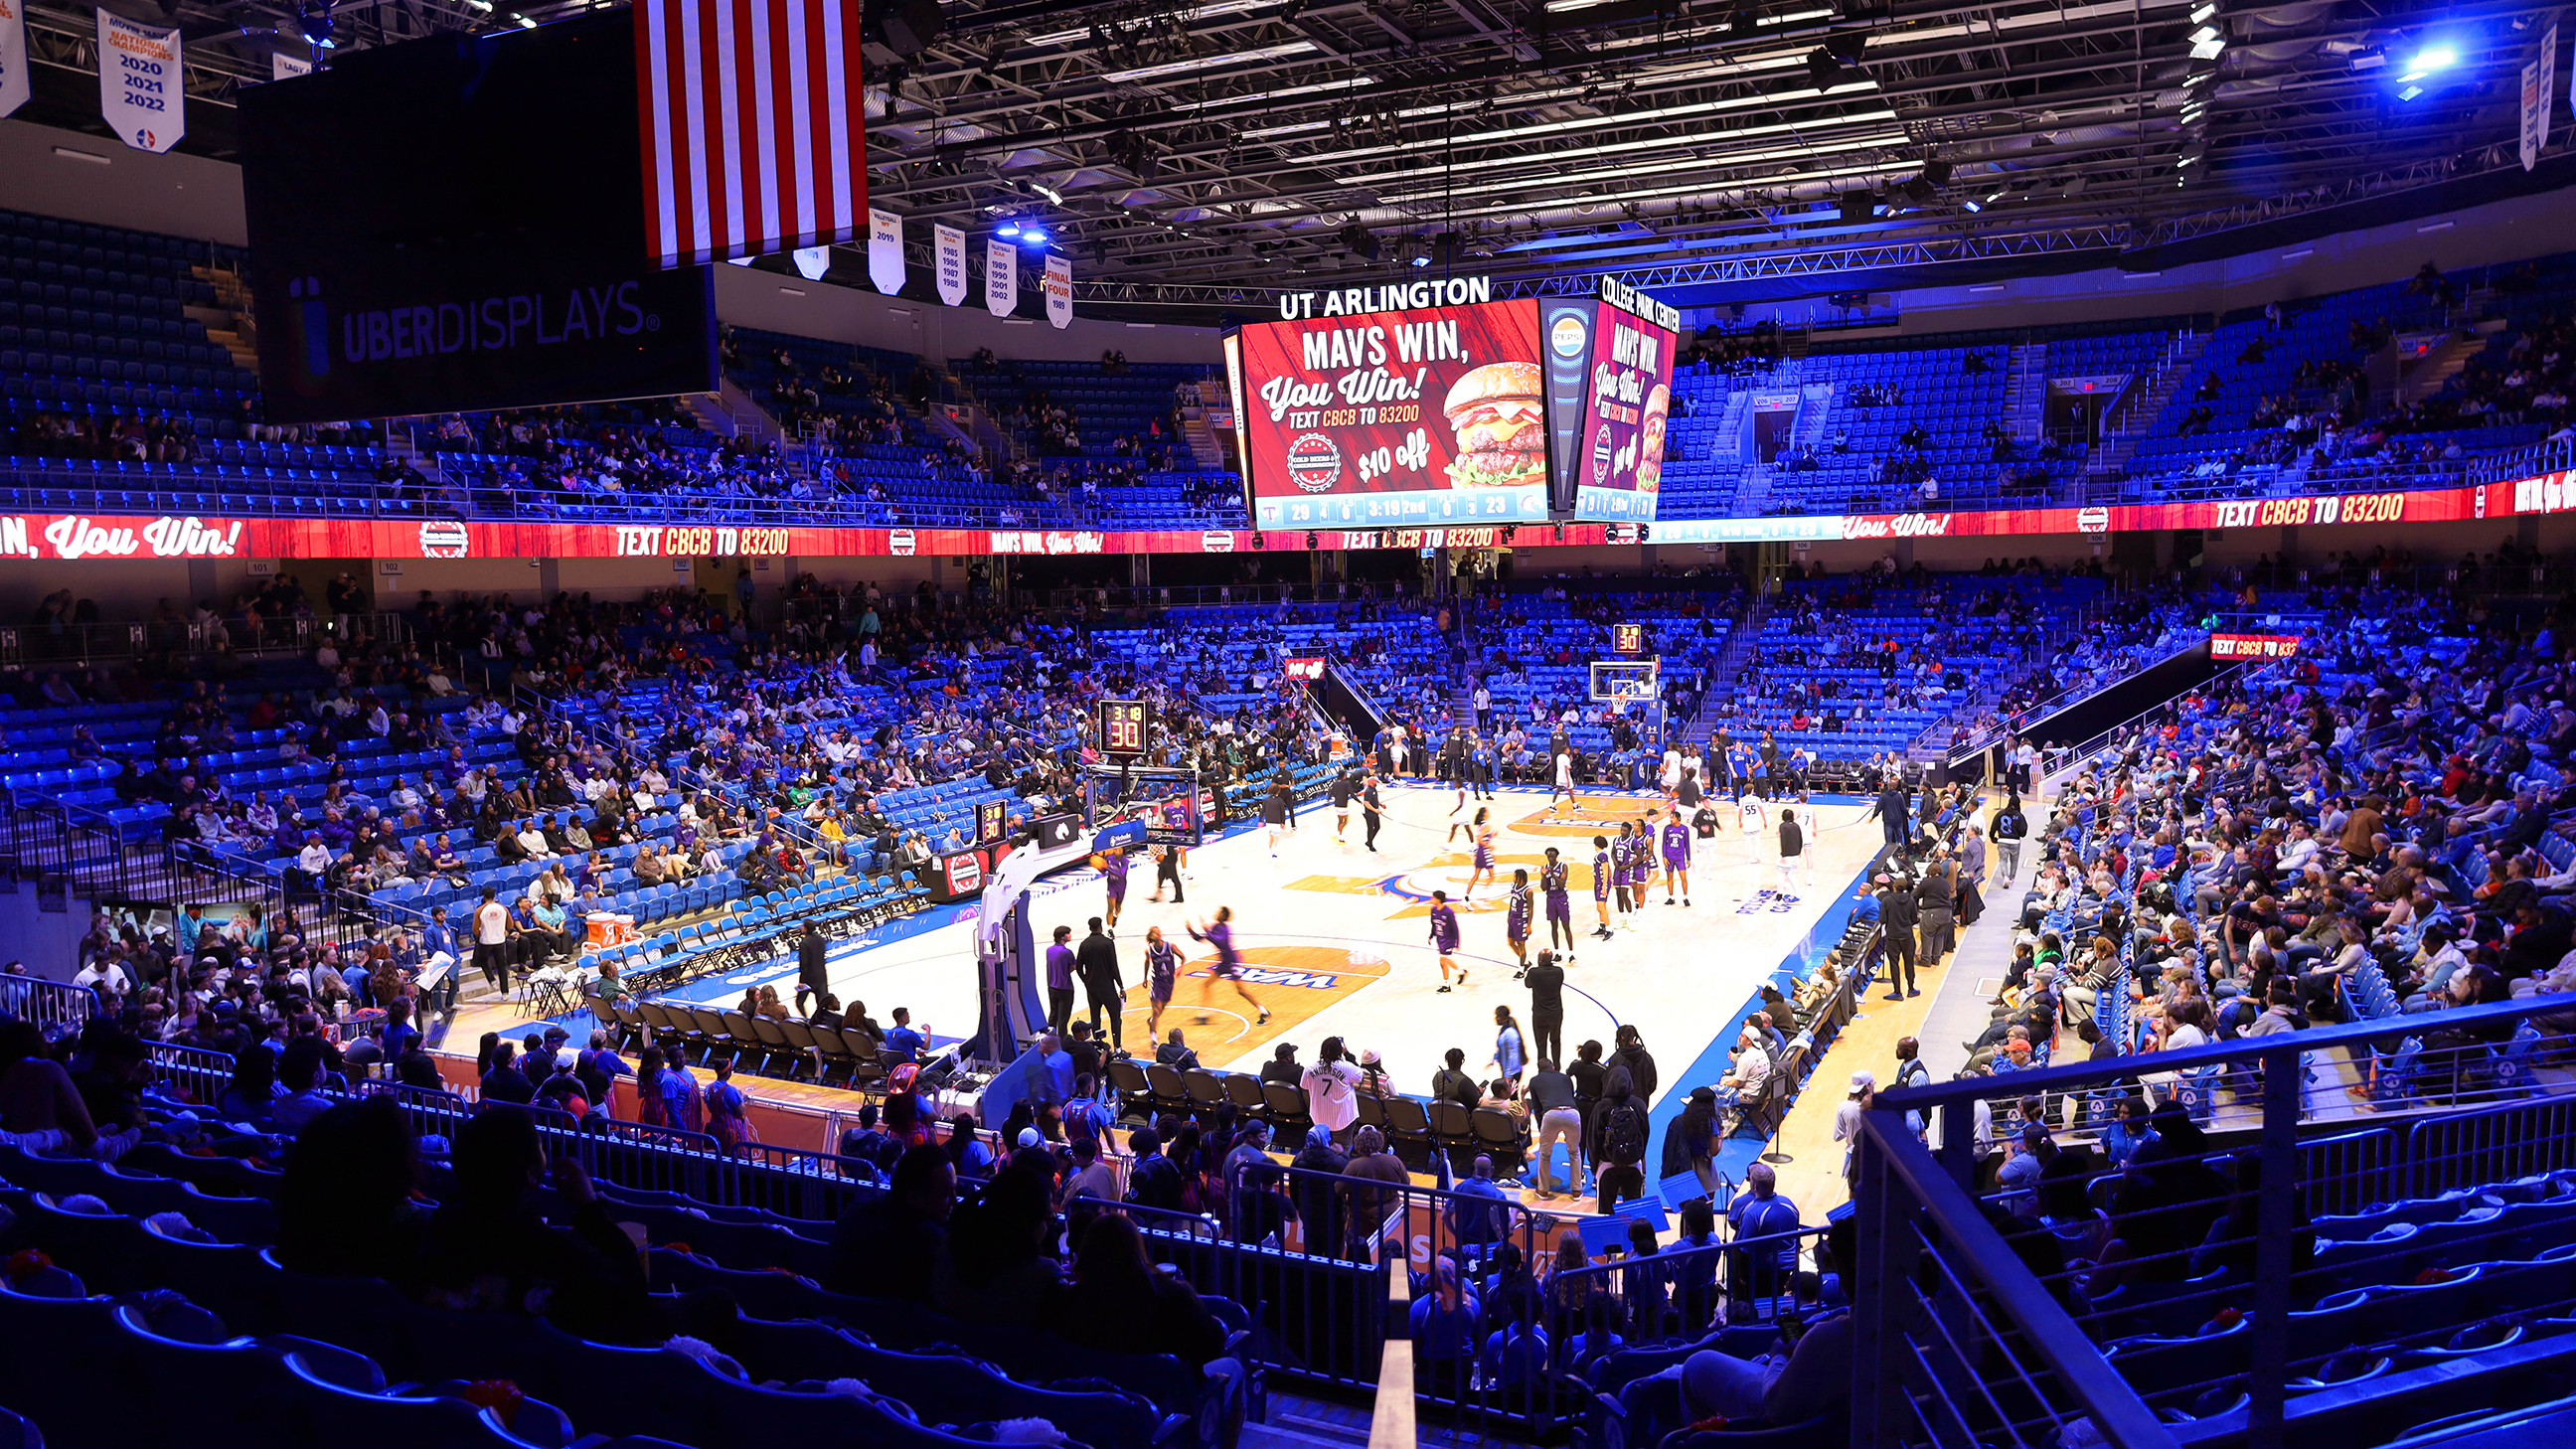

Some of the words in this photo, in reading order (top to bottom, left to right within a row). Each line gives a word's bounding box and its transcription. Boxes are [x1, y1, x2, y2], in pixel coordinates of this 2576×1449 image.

[108, 38, 174, 62] CHAMPIONS
[110, 31, 169, 53] NATIONAL
[120, 54, 163, 76] 2020
[284, 62, 305, 74] LADY
[124, 73, 163, 93] 2021
[124, 91, 165, 112] 2022
[877, 231, 894, 242] 2019
[943, 246, 959, 257] 1985
[943, 257, 959, 268] 1986
[992, 260, 1008, 270] 1989
[943, 267, 959, 278] 1987
[992, 270, 1008, 280] 1990
[1046, 269, 1070, 285] FINAL
[943, 278, 959, 289] 1988
[992, 280, 1008, 290] 2001
[1047, 284, 1069, 298] FOUR
[992, 289, 1008, 299] 2002
[1279, 292, 1315, 321] UT
[1323, 275, 1490, 318] ARLINGTON
[1602, 274, 1635, 314] COLLEGE
[1636, 291, 1655, 323] PARK
[1655, 300, 1681, 334] CENTER
[1302, 326, 1387, 371] MAVS
[1394, 319, 1470, 365] WIN,
[1554, 333, 1582, 342] PEPSI
[1612, 322, 1640, 369] MAVS
[1594, 361, 1618, 408] You
[1260, 375, 1334, 422] You
[1338, 367, 1427, 405] Win!
[1288, 410, 1322, 430] TEXT
[1322, 408, 1358, 427] CBCB
[1359, 407, 1377, 425] TO
[1378, 404, 1420, 423] 83200
[1358, 446, 1391, 484] $10
[1395, 427, 1431, 472] off
[1292, 504, 1311, 521] 29
[1320, 506, 1328, 519] 4
[1342, 506, 1351, 520] 0
[1368, 499, 1400, 517] 3:19
[1402, 499, 1426, 514] 2nd
[1442, 502, 1452, 517] 0
[1468, 502, 1476, 515] 3
[1485, 495, 1507, 514] 23
[2216, 501, 2260, 528] TEXT
[2260, 499, 2311, 525] CBCB
[2314, 496, 2339, 524] TO
[2340, 493, 2405, 522] 83200
[1843, 515, 1888, 540] You
[1890, 513, 1951, 537] Win!
[44, 515, 139, 560] You
[143, 516, 242, 557] Win!
[615, 527, 663, 557] TEXT
[665, 527, 712, 557] CBCB
[715, 528, 739, 557] TO
[739, 528, 790, 556] 83200
[991, 532, 1021, 554] MAVS
[1046, 531, 1074, 556] You
[1072, 531, 1105, 555] Win!
[1342, 531, 1378, 550] TEXT
[1423, 528, 1445, 549] TO
[1445, 527, 1494, 548] 83200
[252, 564, 267, 572] 101
[1619, 635, 1637, 649] 30
[2211, 639, 2236, 655] TEXT
[2236, 640, 2263, 656] CBCB
[2263, 641, 2278, 656] TO
[1114, 706, 1142, 722] 3:18
[1111, 722, 1139, 747] 30
[1745, 805, 1756, 815] 55
[1805, 815, 1810, 826] 7
[2000, 815, 2012, 834] 8
[984, 821, 999, 840] 30
[1310, 1065, 1347, 1080] ANDERSON
[1322, 1078, 1333, 1096] 7
